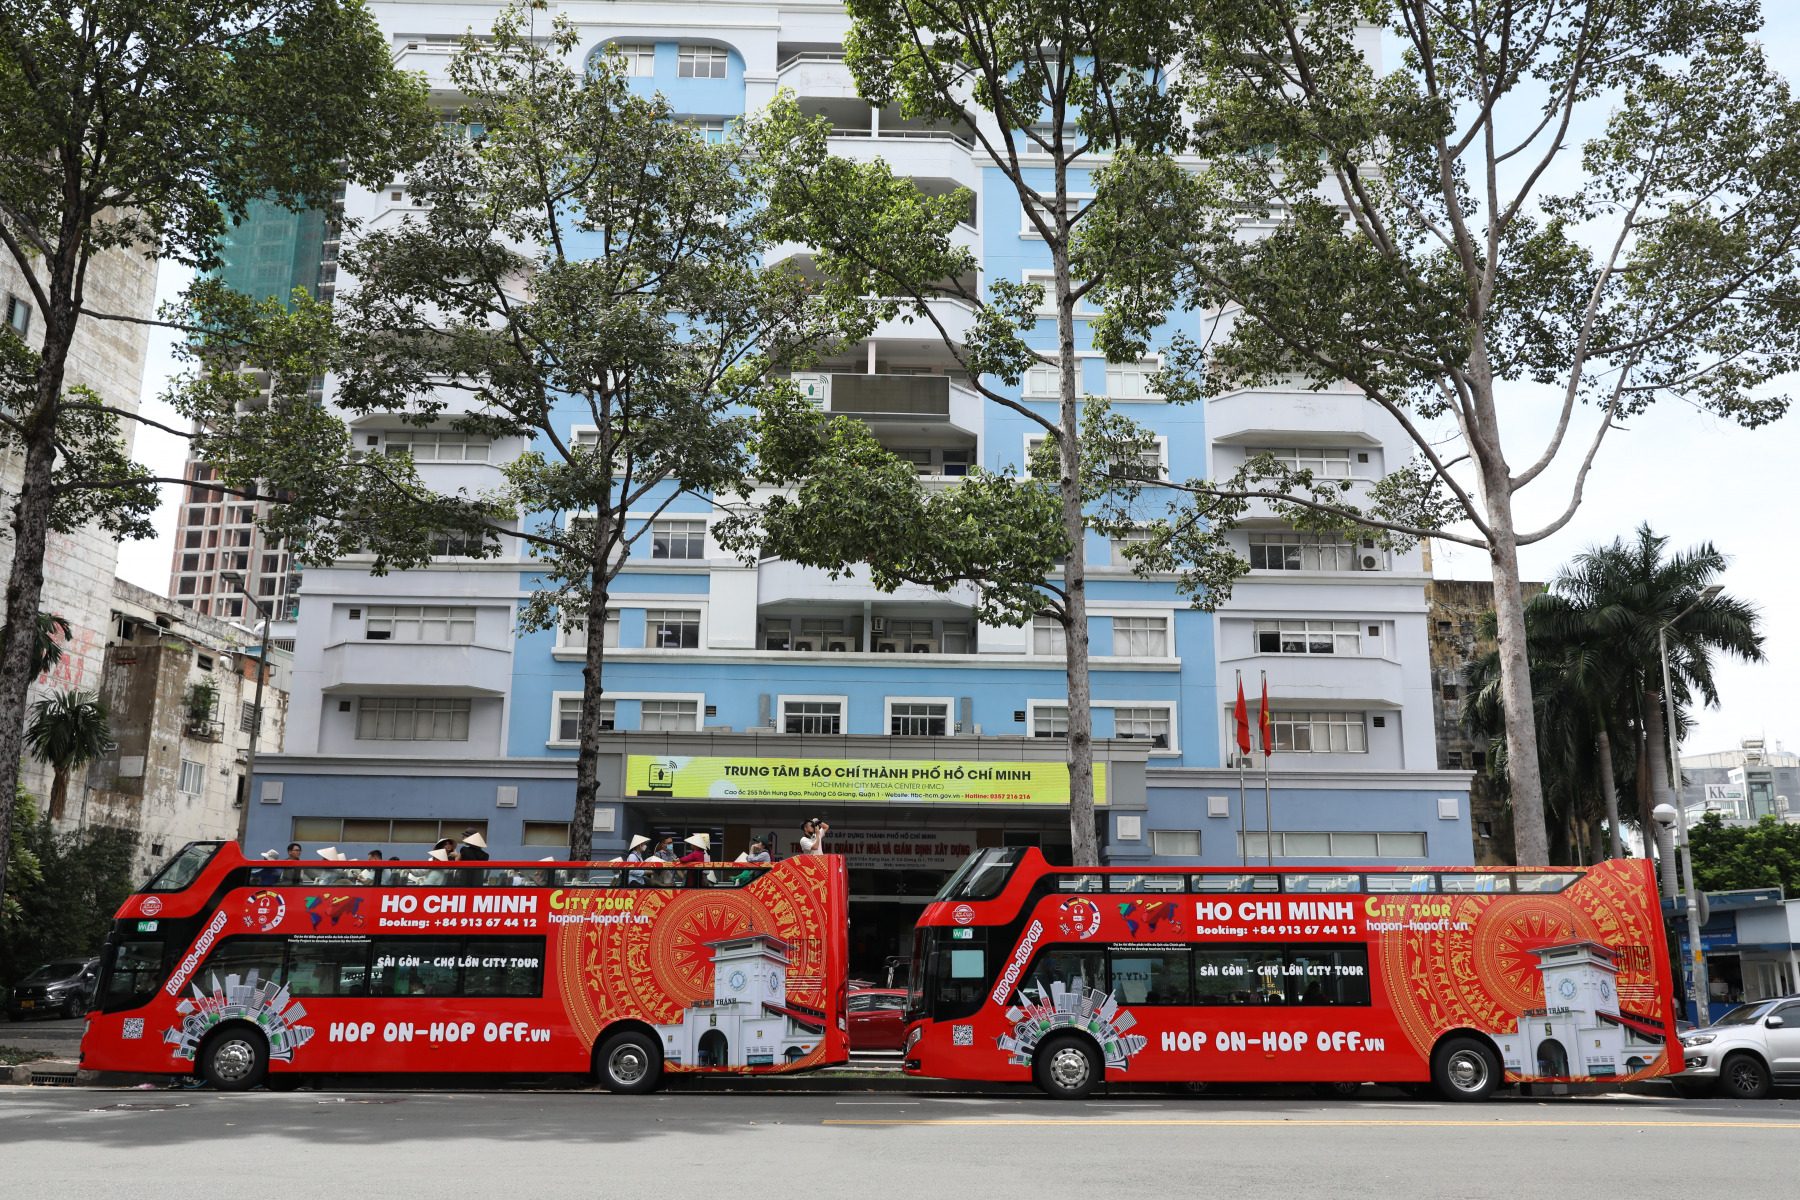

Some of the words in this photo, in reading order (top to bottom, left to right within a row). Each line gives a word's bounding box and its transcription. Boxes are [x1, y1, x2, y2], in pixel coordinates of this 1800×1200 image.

[725, 766, 769, 777] TRUNG
[772, 765, 799, 777] TÂM
[803, 765, 831, 778] BÁO
[835, 765, 860, 778] CHÍ
[863, 766, 908, 779] THÀNH
[912, 765, 941, 779] PHỐ
[944, 766, 964, 780] HỒ
[968, 767, 993, 780] CHÍ
[996, 770, 1031, 781] MINH
[1709, 786, 1726, 798] KK
[835, 841, 854, 854] QUẢN
[856, 841, 864, 854] LÝ
[867, 842, 881, 854] NHÀ
[882, 842, 891, 855] VÀ
[894, 842, 912, 855] GIÁM
[915, 844, 932, 857] ĐỊNH
[935, 843, 948, 855] XÂY
[951, 844, 970, 858] DỰNG
[381, 895, 418, 913] HO
[423, 895, 467, 913] CHI
[473, 895, 538, 913] MINH
[550, 890, 590, 910] CITY
[595, 897, 634, 910] TOUR
[1365, 896, 1406, 917] CITY
[1411, 904, 1451, 917] TOUR
[548, 911, 649, 926] hopon-hopoff.vn
[1196, 902, 1233, 921] HO
[1238, 902, 1282, 921] CHI
[1288, 902, 1354, 920] MINH
[379, 918, 430, 929] Booking:
[435, 918, 456, 927] +84
[460, 918, 482, 927] 913
[486, 918, 501, 927] 67
[504, 918, 518, 927] 44
[523, 919, 537, 927] 12
[1197, 925, 1248, 937] Booking:
[1252, 925, 1275, 935] +84
[1279, 925, 1301, 935] 913
[1304, 925, 1319, 935] 67
[1322, 925, 1338, 935] 44
[1342, 925, 1356, 935] 12
[1366, 919, 1469, 934] hopon-hopoff.vn
[166, 969, 185, 996] HOP
[210, 910, 228, 934] OFF
[377, 954, 395, 968] SÀI
[398, 955, 420, 967] GÒN
[434, 956, 455, 969] CHỢ
[458, 955, 479, 968] LỚN
[482, 958, 507, 968] CITY
[510, 958, 538, 968] TOUR
[992, 978, 1010, 1006] HOP
[1027, 919, 1044, 942] OFF
[1200, 963, 1218, 976] SÀI
[1222, 963, 1244, 976] GÒN
[1257, 965, 1279, 978] CHỢ
[1282, 963, 1303, 976] LỚN
[1306, 966, 1332, 976] CITY
[1334, 966, 1364, 976] TOUR
[716, 997, 737, 1006] THÀNH
[329, 1022, 375, 1042] HOP
[483, 1022, 550, 1042] OFF.VN
[1161, 1031, 1207, 1052] HOP
[1316, 1031, 1385, 1052] OFF.VN
